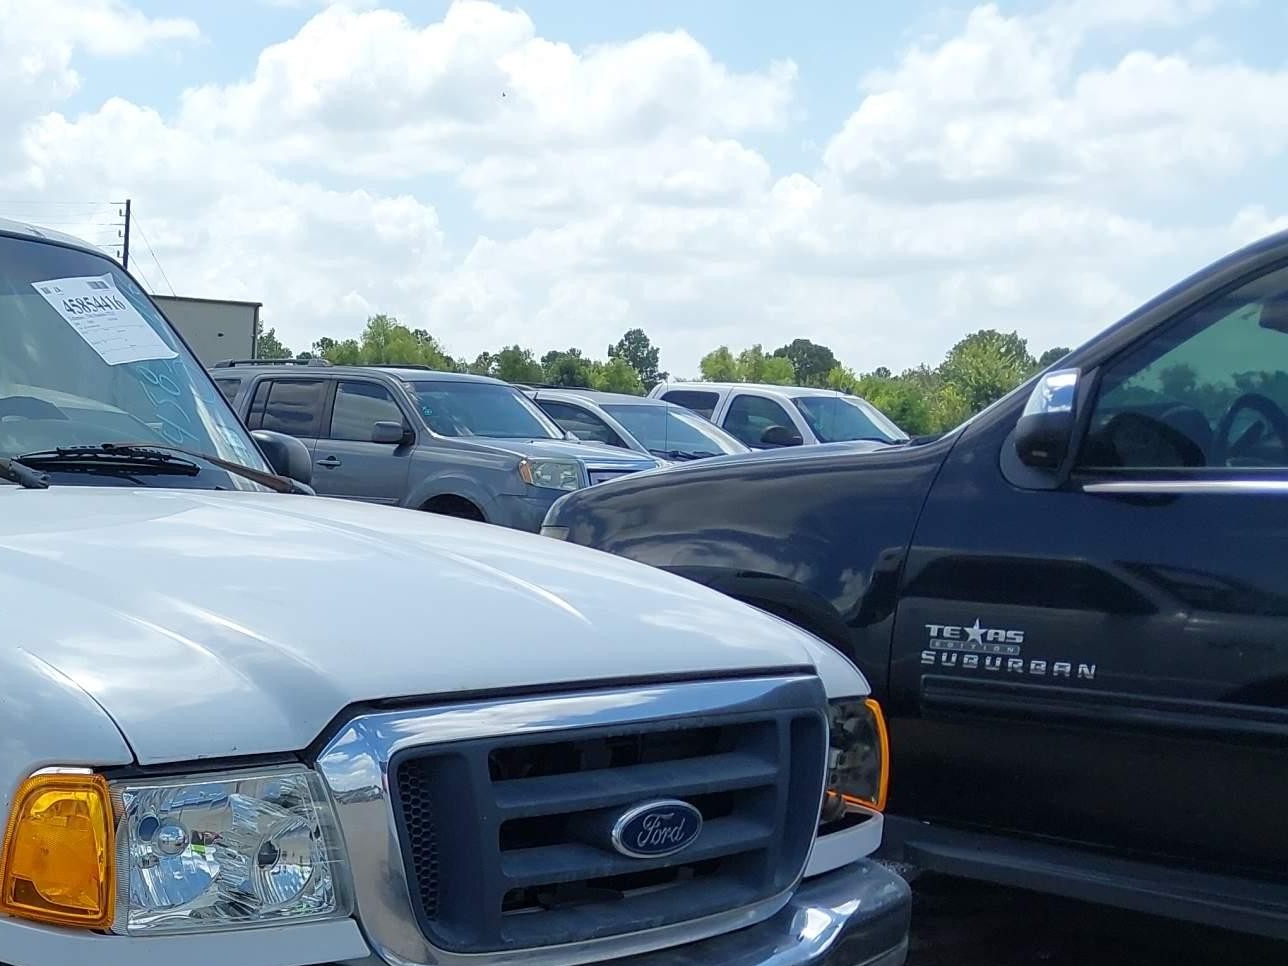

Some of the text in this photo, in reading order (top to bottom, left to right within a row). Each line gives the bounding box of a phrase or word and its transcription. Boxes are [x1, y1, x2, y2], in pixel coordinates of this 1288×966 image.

[63, 295, 126, 314] 45854416
[921, 650, 1097, 679] SUBURBAN
[637, 812, 685, 847] Ford
